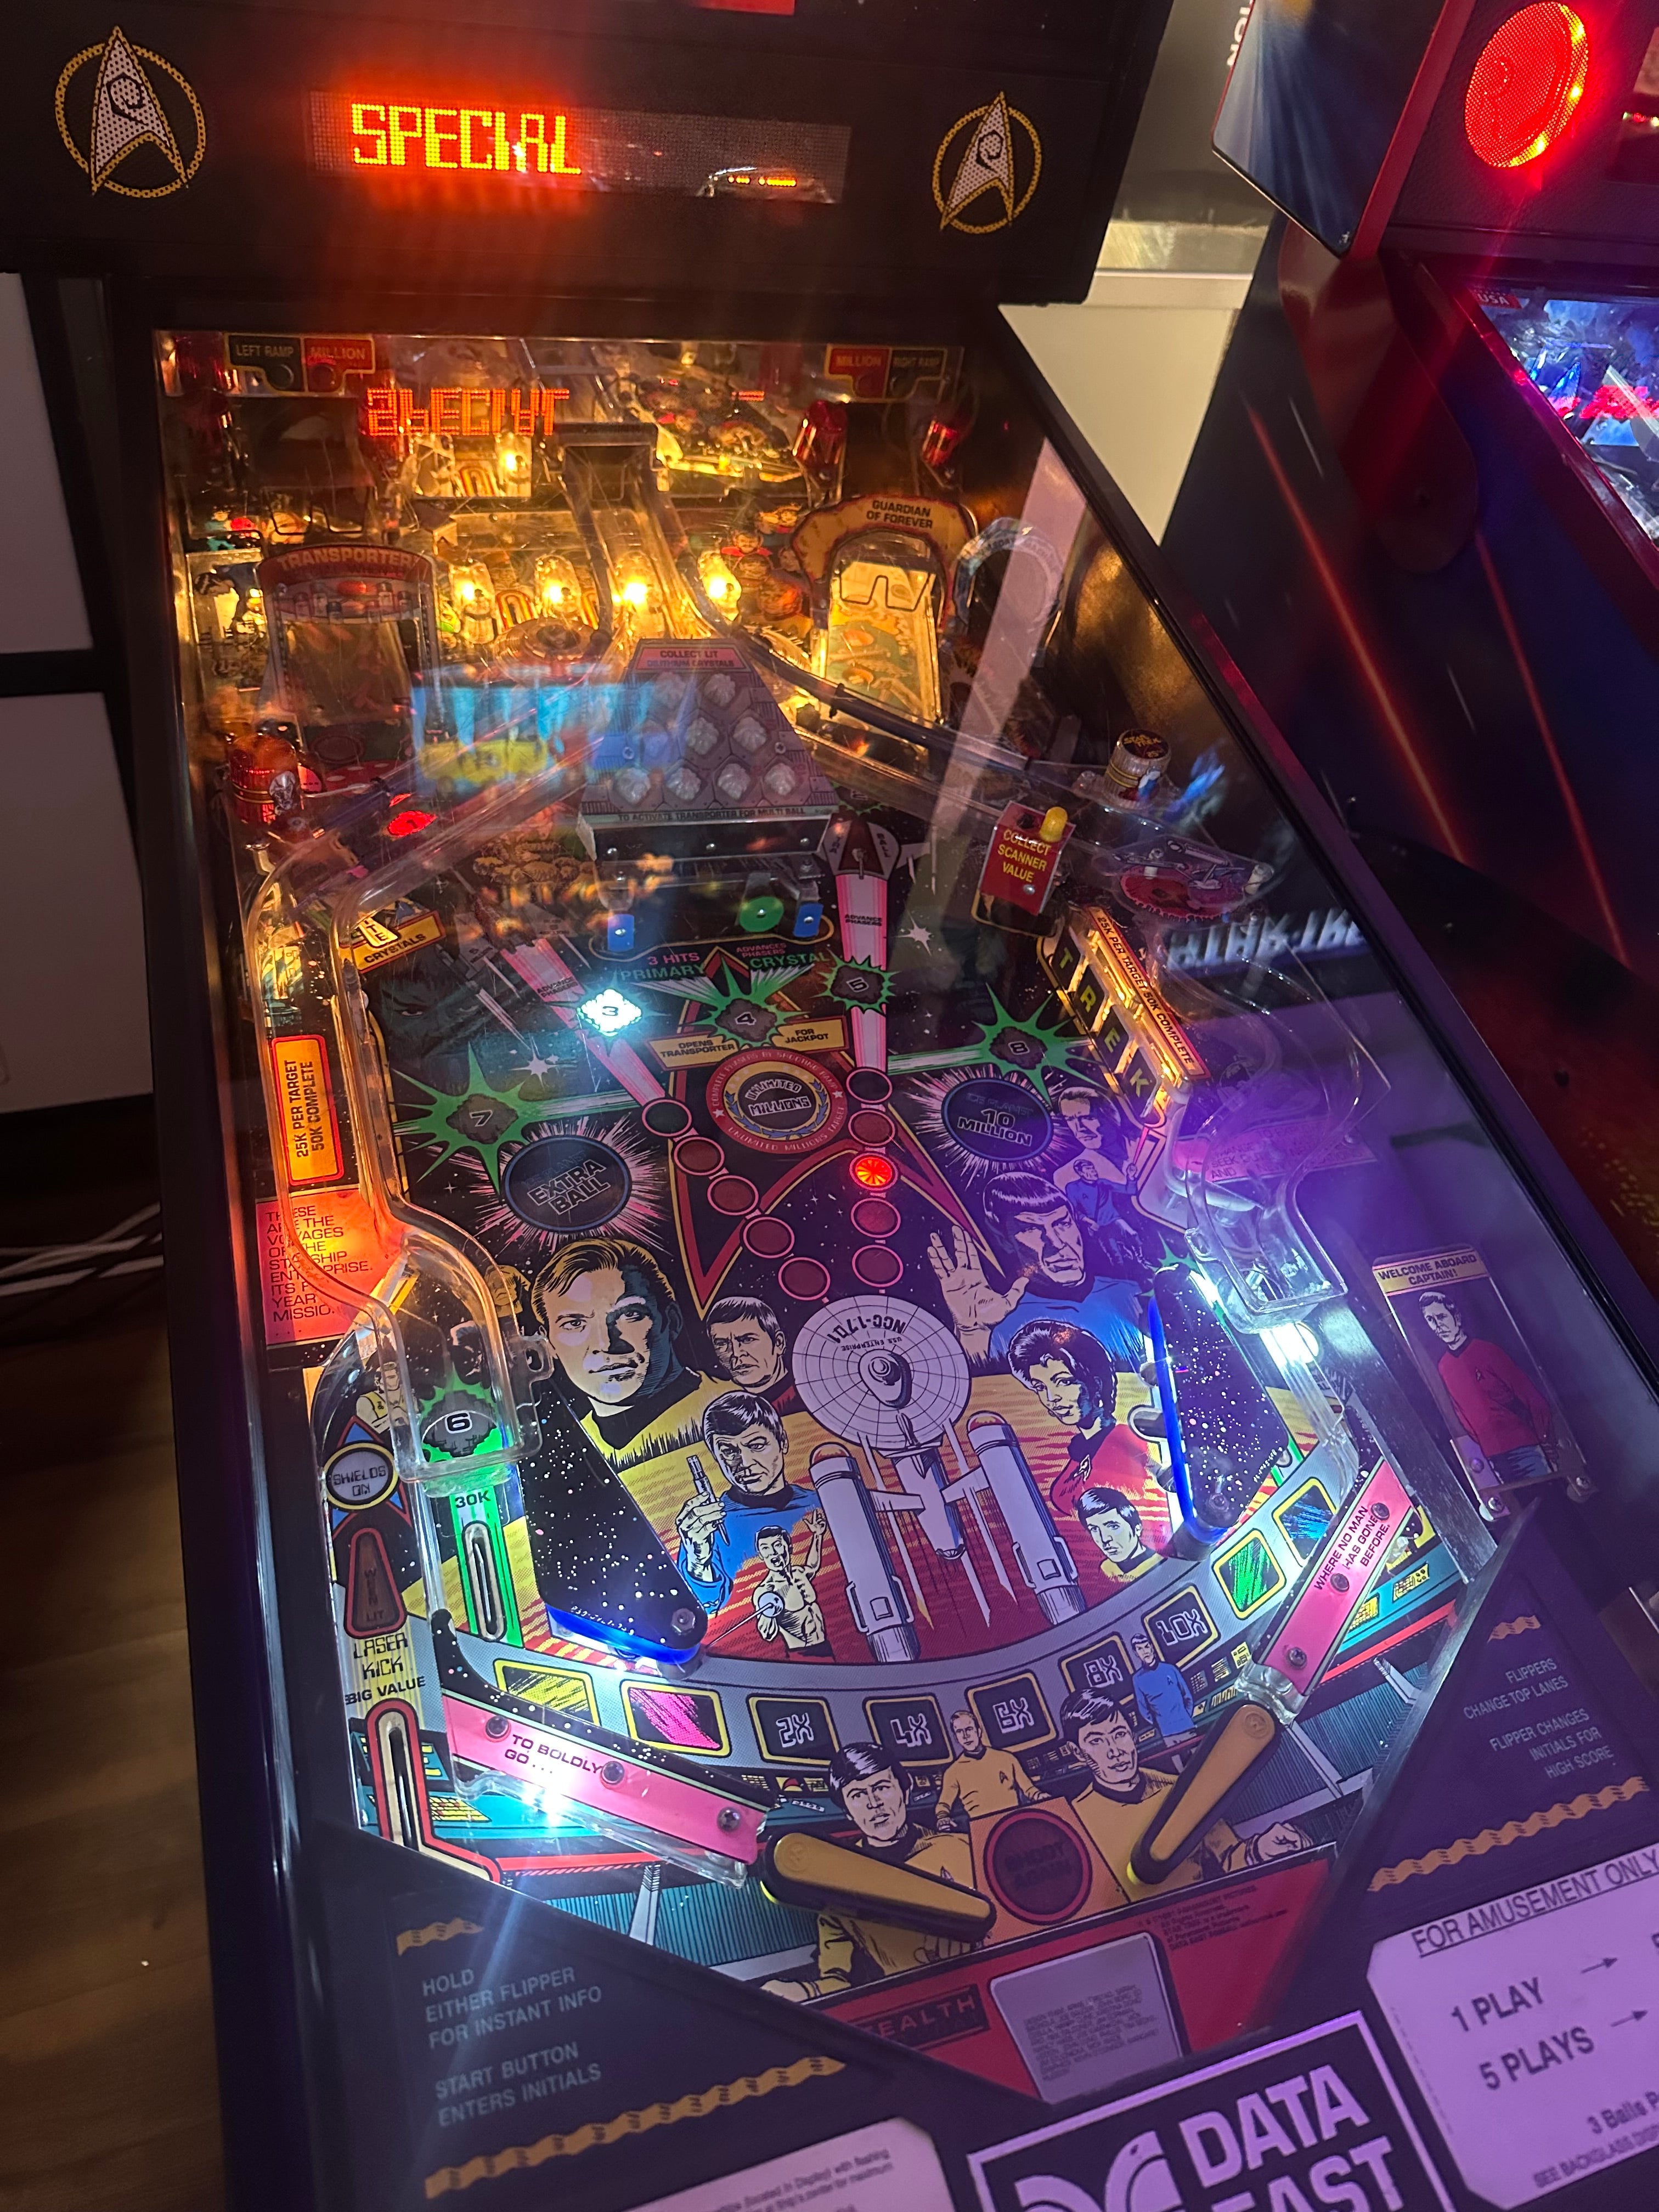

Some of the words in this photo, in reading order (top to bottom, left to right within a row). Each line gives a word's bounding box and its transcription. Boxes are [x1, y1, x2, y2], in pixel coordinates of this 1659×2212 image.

[351, 103, 582, 174] SPECIAL
[236, 344, 261, 357] LEFT
[264, 345, 295, 357] RAMP
[309, 346, 366, 360] MILLION
[866, 510, 881, 521] OF
[884, 512, 934, 529] FOREVER
[872, 500, 932, 517] GUARDIAN
[660, 650, 702, 658] COLLECT
[618, 814, 629, 822] TO
[632, 812, 673, 822] ACTIVATE
[675, 810, 738, 821] TRANSPORTER
[1003, 828, 1052, 856] COLLECT
[997, 843, 1048, 872] SCANNER
[1002, 861, 1035, 883] VALUE
[844, 914, 883, 922] ADVANCE
[364, 934, 426, 963] CRYSTALS
[647, 956, 658, 966] 3
[663, 952, 701, 964] HITS
[749, 952, 830, 970] CRYSTAL
[619, 963, 706, 981] PRIMARY
[847, 978, 870, 993] 5
[601, 1005, 619, 1017] 3
[1110, 936, 1125, 954] PER
[1123, 956, 1148, 991] TARGET
[1143, 991, 1161, 1011] 50K
[1156, 1013, 1195, 1064] COMPLETE
[735, 1011, 758, 1026] 4
[678, 1039, 714, 1049] OPENS
[785, 1032, 830, 1043] JACKPOT
[795, 1028, 815, 1036] FOR
[659, 1043, 736, 1058] TRANSPORTER
[1009, 1042, 1029, 1055] 8
[284, 1059, 303, 1104] TARGET
[300, 1061, 321, 1124] COMPLETE
[744, 1078, 803, 1101] UNLIMITED
[290, 1105, 306, 1130] PER
[469, 1109, 494, 1127] 7
[748, 1096, 812, 1117] MILLIONS
[980, 1108, 1015, 1130] 10
[309, 1126, 325, 1152] 50K
[728, 1126, 778, 1151] UNLIMITED
[784, 1133, 828, 1151] MILLIONS
[957, 1116, 1033, 1147] MILLION
[292, 1132, 309, 1158] 25K
[526, 1159, 607, 1206] EXTRA
[548, 1176, 611, 1216] BALL
[303, 1215, 335, 1228] THE
[1378, 1262, 1434, 1280] WELCOME
[1435, 1254, 1477, 1270] ABOARD
[1408, 1268, 1458, 1285] CAPTAIN!
[272, 1283, 296, 1296] ITS
[272, 1293, 317, 1308] YEAR
[827, 1314, 906, 1344] NCC-1701
[840, 1339, 885, 1351] ENTERPRISE
[444, 1412, 473, 1435] 6
[332, 1464, 387, 1487] SHIELDS
[352, 1482, 371, 1498] ON
[454, 1490, 492, 1509] 30K
[1313, 1549, 1342, 1590] WHERE
[1337, 1532, 1353, 1551] NO
[1348, 1505, 1369, 1533] MAN
[1342, 1544, 1361, 1570] HAS
[1357, 1515, 1379, 1545] GONE
[1359, 1523, 1391, 1567] BEFORE.
[1155, 1607, 1209, 1646] 10X
[353, 1632, 408, 1659] LASER
[362, 1656, 404, 1680] KICK
[1083, 1652, 1124, 1689] 8X
[1505, 1657, 1558, 1684] FLIPPERS
[346, 1688, 374, 1705] BIG
[377, 1675, 427, 1698] VALUE
[1463, 1694, 1511, 1720] CHANGE
[1511, 1688, 1531, 1705] TOP
[1532, 1675, 1568, 1698] LANES
[992, 1696, 1035, 1734] 6X
[775, 1712, 815, 1748] 2X
[889, 1711, 933, 1748] 4X
[1489, 1726, 1537, 1752] FLIPPER
[1536, 1708, 1589, 1735] CHANGES
[512, 1734, 534, 1750] TO
[537, 1743, 603, 1774] BOLDLY
[1528, 1735, 1577, 1761] INITIALS
[1577, 1726, 1602, 1745] FOR
[1544, 1759, 1573, 1779] HIGH
[1573, 1745, 1614, 1770] SCORE
[1411, 1918, 1465, 1953] FOR
[1469, 1869, 1602, 1936] AMUSEMENT
[1604, 1849, 1659, 1886] ONLY
[422, 1968, 475, 1996] HOLD
[425, 1989, 494, 2023] EITHER
[499, 1966, 575, 2001] FLIPPER
[428, 2023, 469, 2050] FOR
[475, 1999, 551, 2037] INSTANT
[557, 1985, 602, 2013] INFO
[1451, 2005, 1469, 2032] 1
[1471, 1977, 1544, 2026] PLAY
[435, 2066, 493, 2100] START
[500, 2041, 579, 2080] BUTTON
[1479, 2061, 1501, 2091] 5
[1500, 2027, 1594, 2082] PLAYS
[438, 2088, 516, 2128] ENTERS
[521, 2062, 602, 2102] INITIALS
[1178, 2064, 1370, 2188] DATA
[1587, 2115, 1602, 2134] 3
